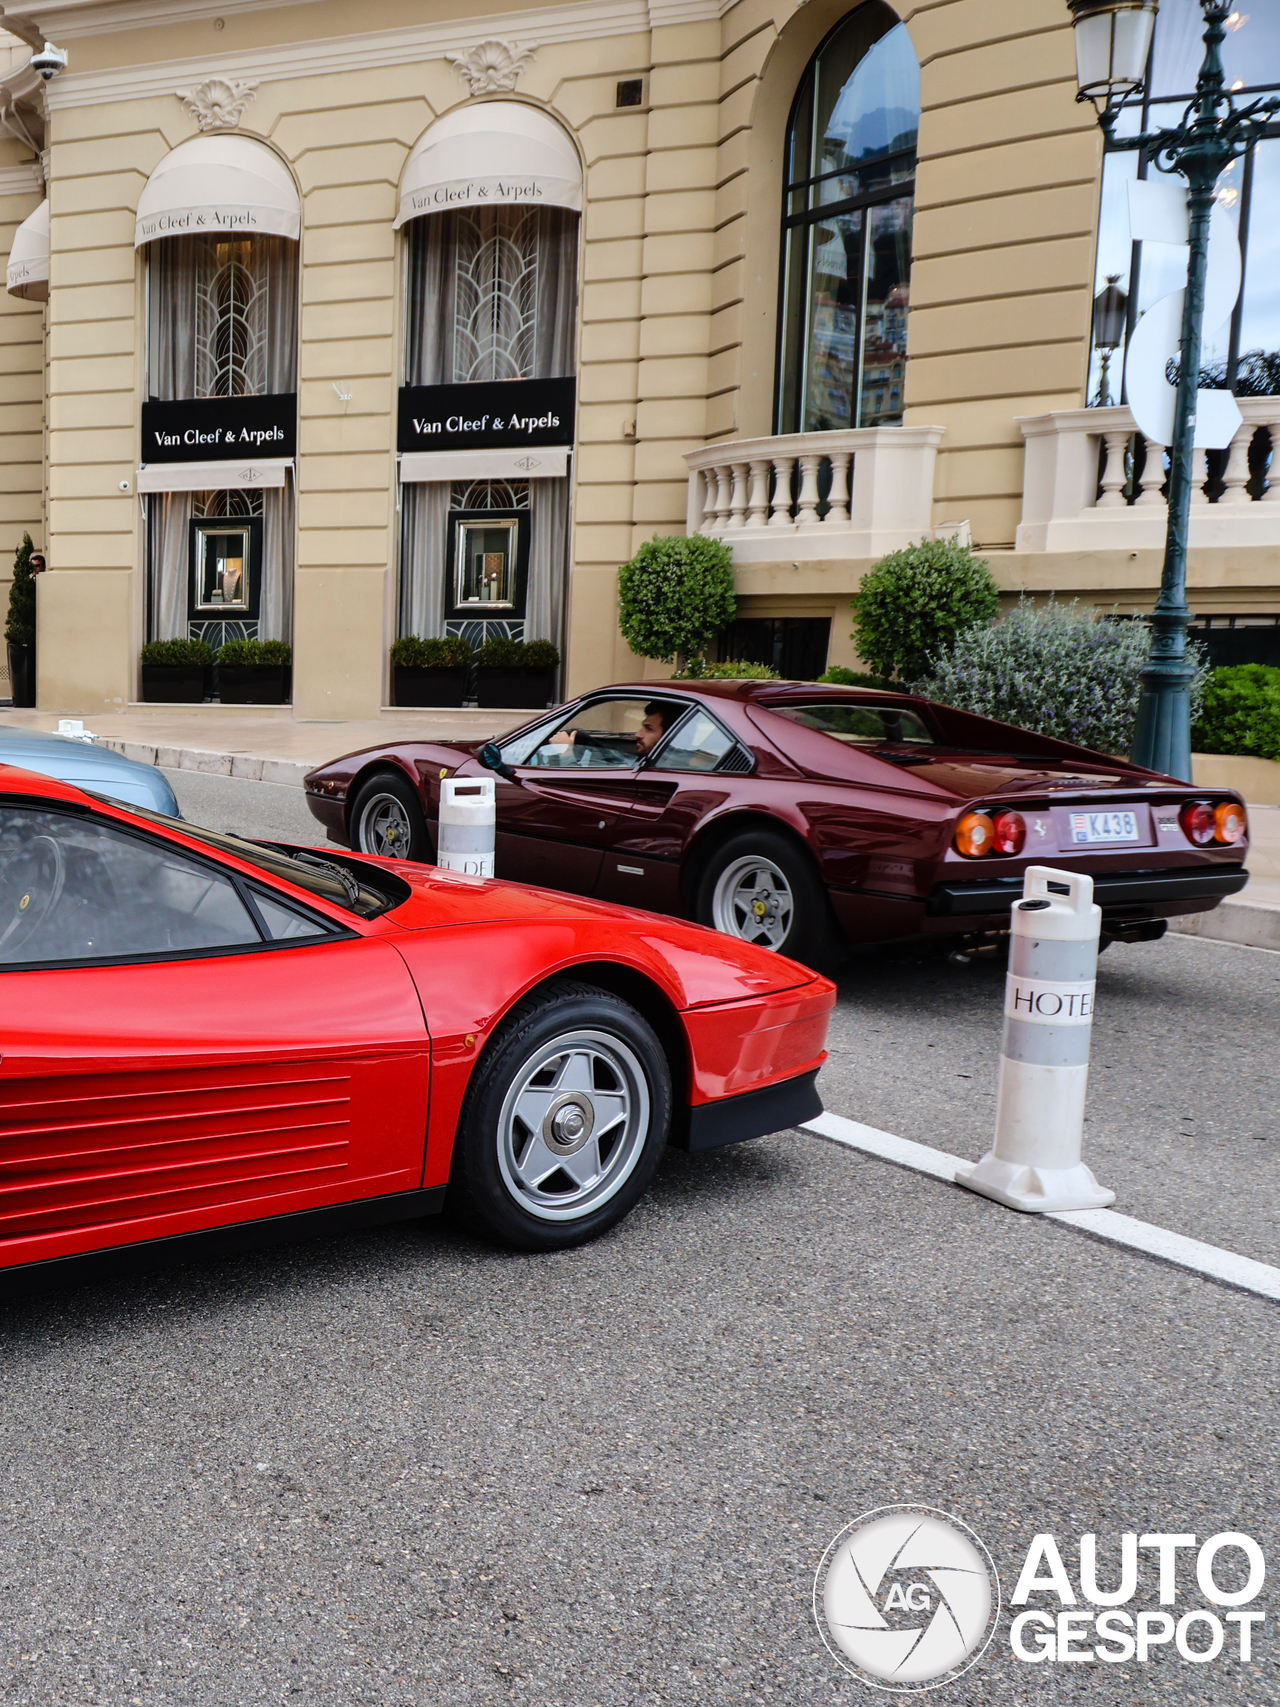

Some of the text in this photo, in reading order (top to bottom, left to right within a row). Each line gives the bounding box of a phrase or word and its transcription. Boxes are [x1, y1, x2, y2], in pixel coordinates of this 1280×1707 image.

[412, 182, 543, 209] Van Cleef & Arpels
[142, 211, 257, 235] Van Cleef & Arpels
[412, 411, 560, 434] Van Cleef & Arpels
[154, 425, 285, 446] Van Cleef & Arpels
[1089, 813, 1134, 836] K438
